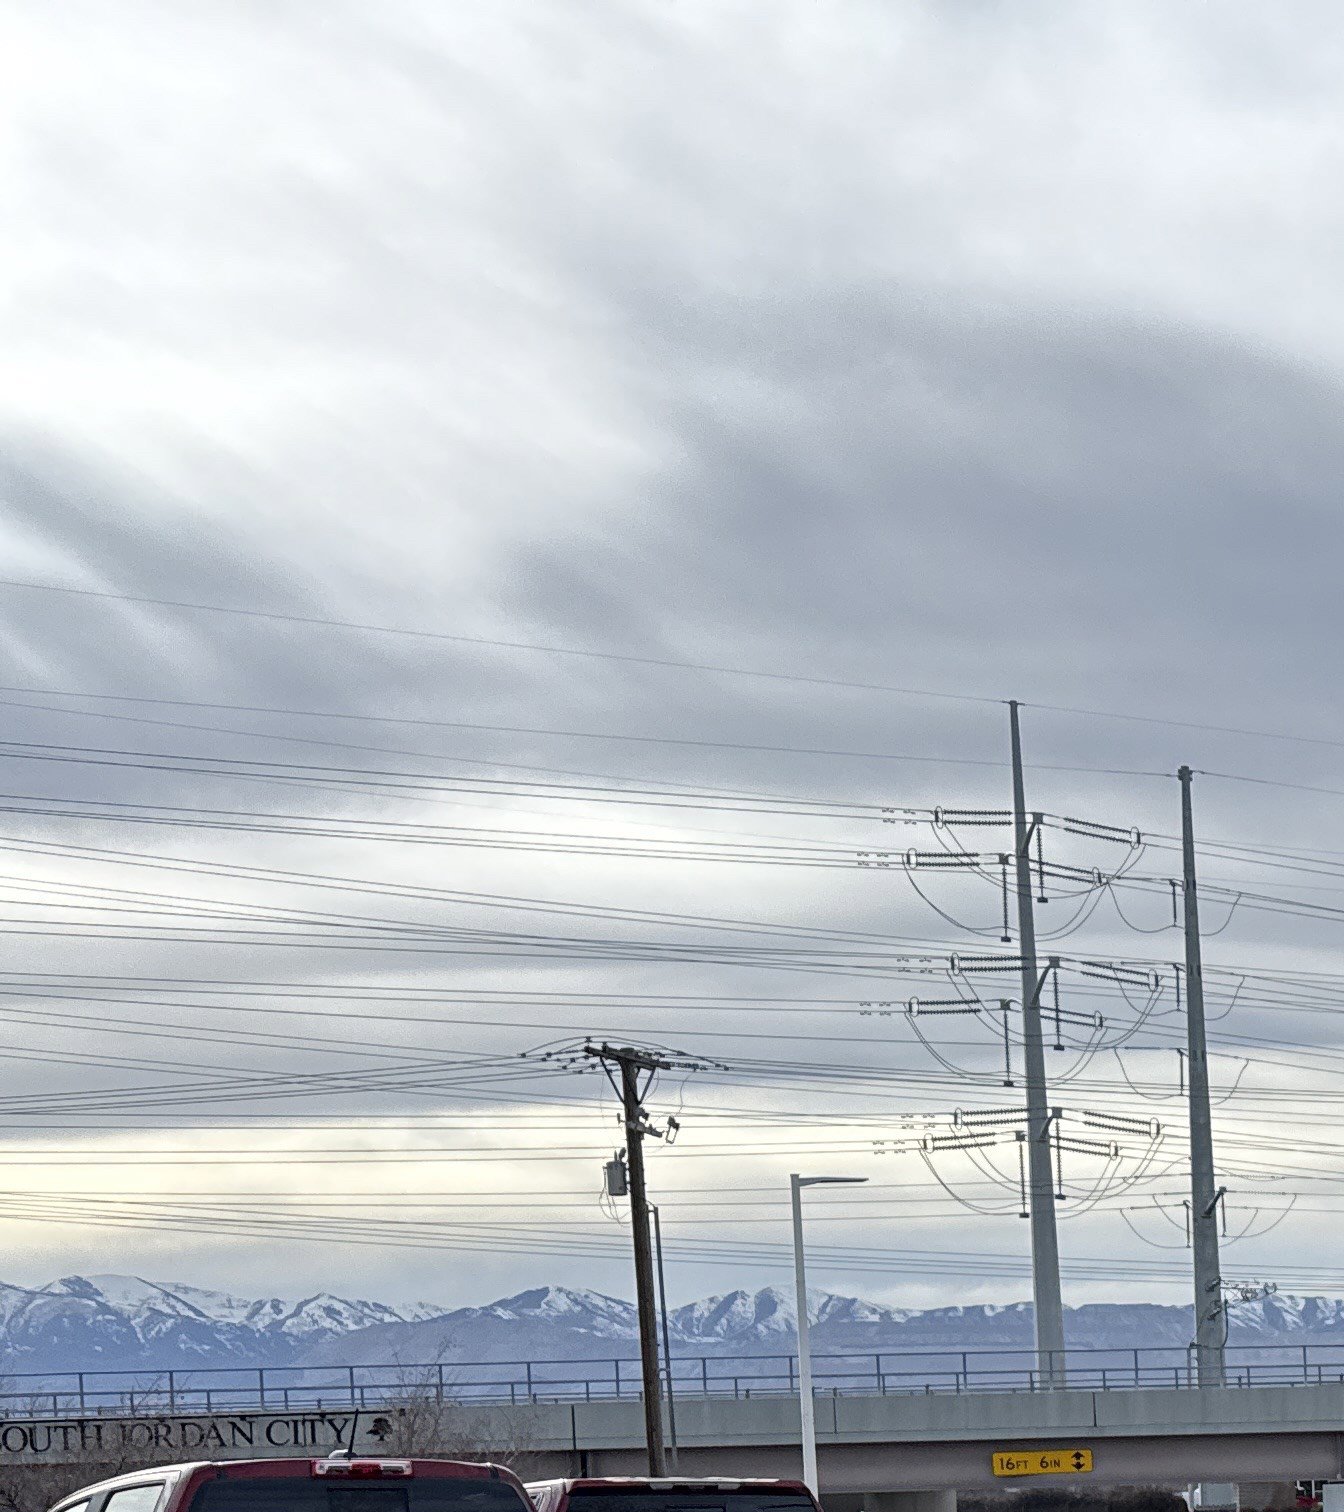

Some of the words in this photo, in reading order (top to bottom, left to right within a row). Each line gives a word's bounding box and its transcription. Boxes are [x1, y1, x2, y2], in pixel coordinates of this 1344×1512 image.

[0, 1420, 104, 1452] OUTH
[120, 1419, 254, 1449] JORDAN
[265, 1417, 351, 1447] CITY
[999, 1457, 1028, 1471] 16FT
[1040, 1456, 1061, 1469] 6IN
